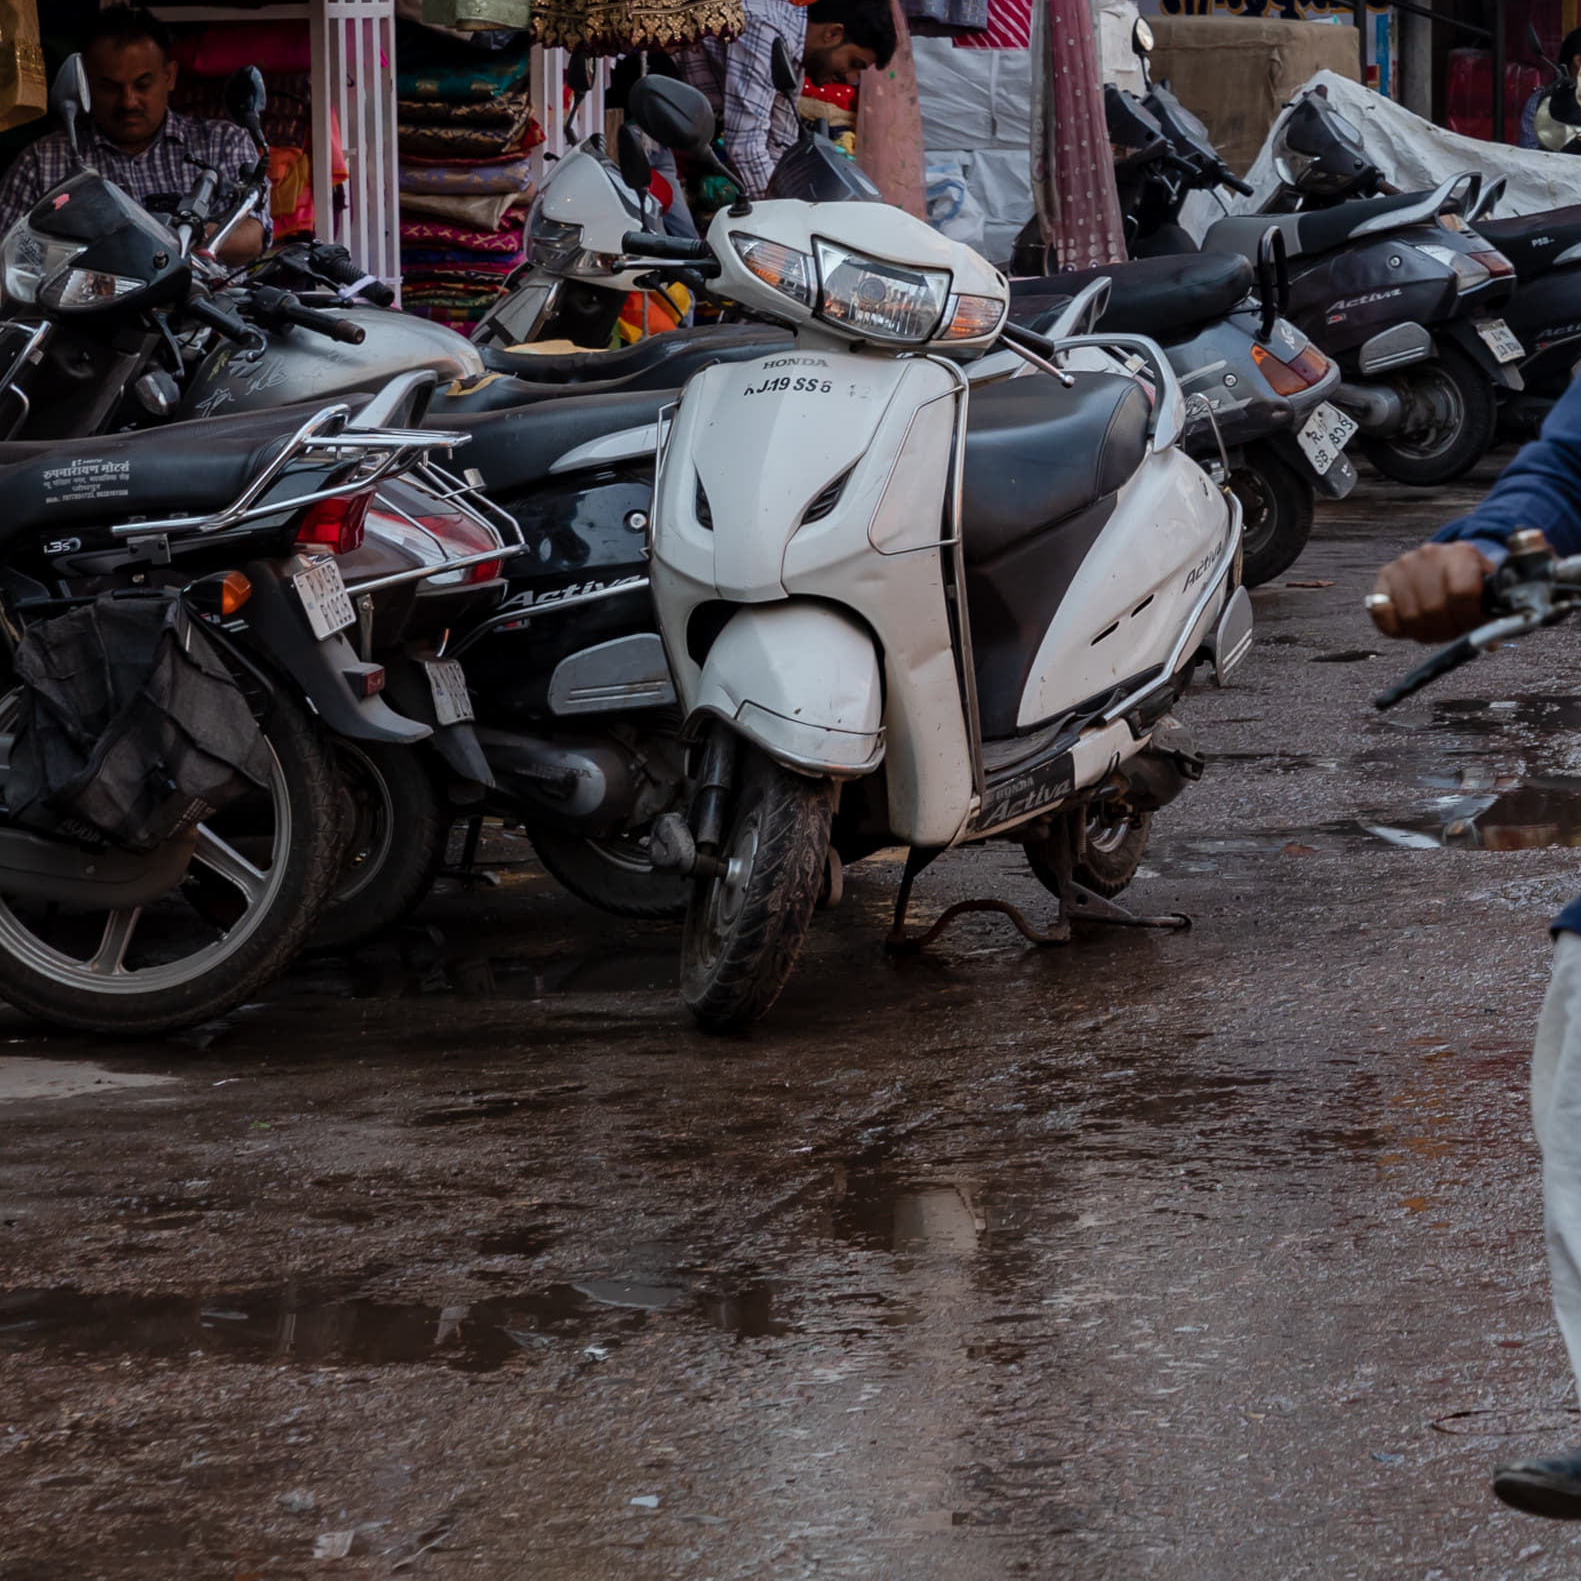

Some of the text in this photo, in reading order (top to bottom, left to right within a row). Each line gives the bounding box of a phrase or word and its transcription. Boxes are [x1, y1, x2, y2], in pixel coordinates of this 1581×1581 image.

[1326, 288, 1403, 314] Activa
[761, 358, 829, 371] HONDA
[1182, 539, 1224, 594] Activa
